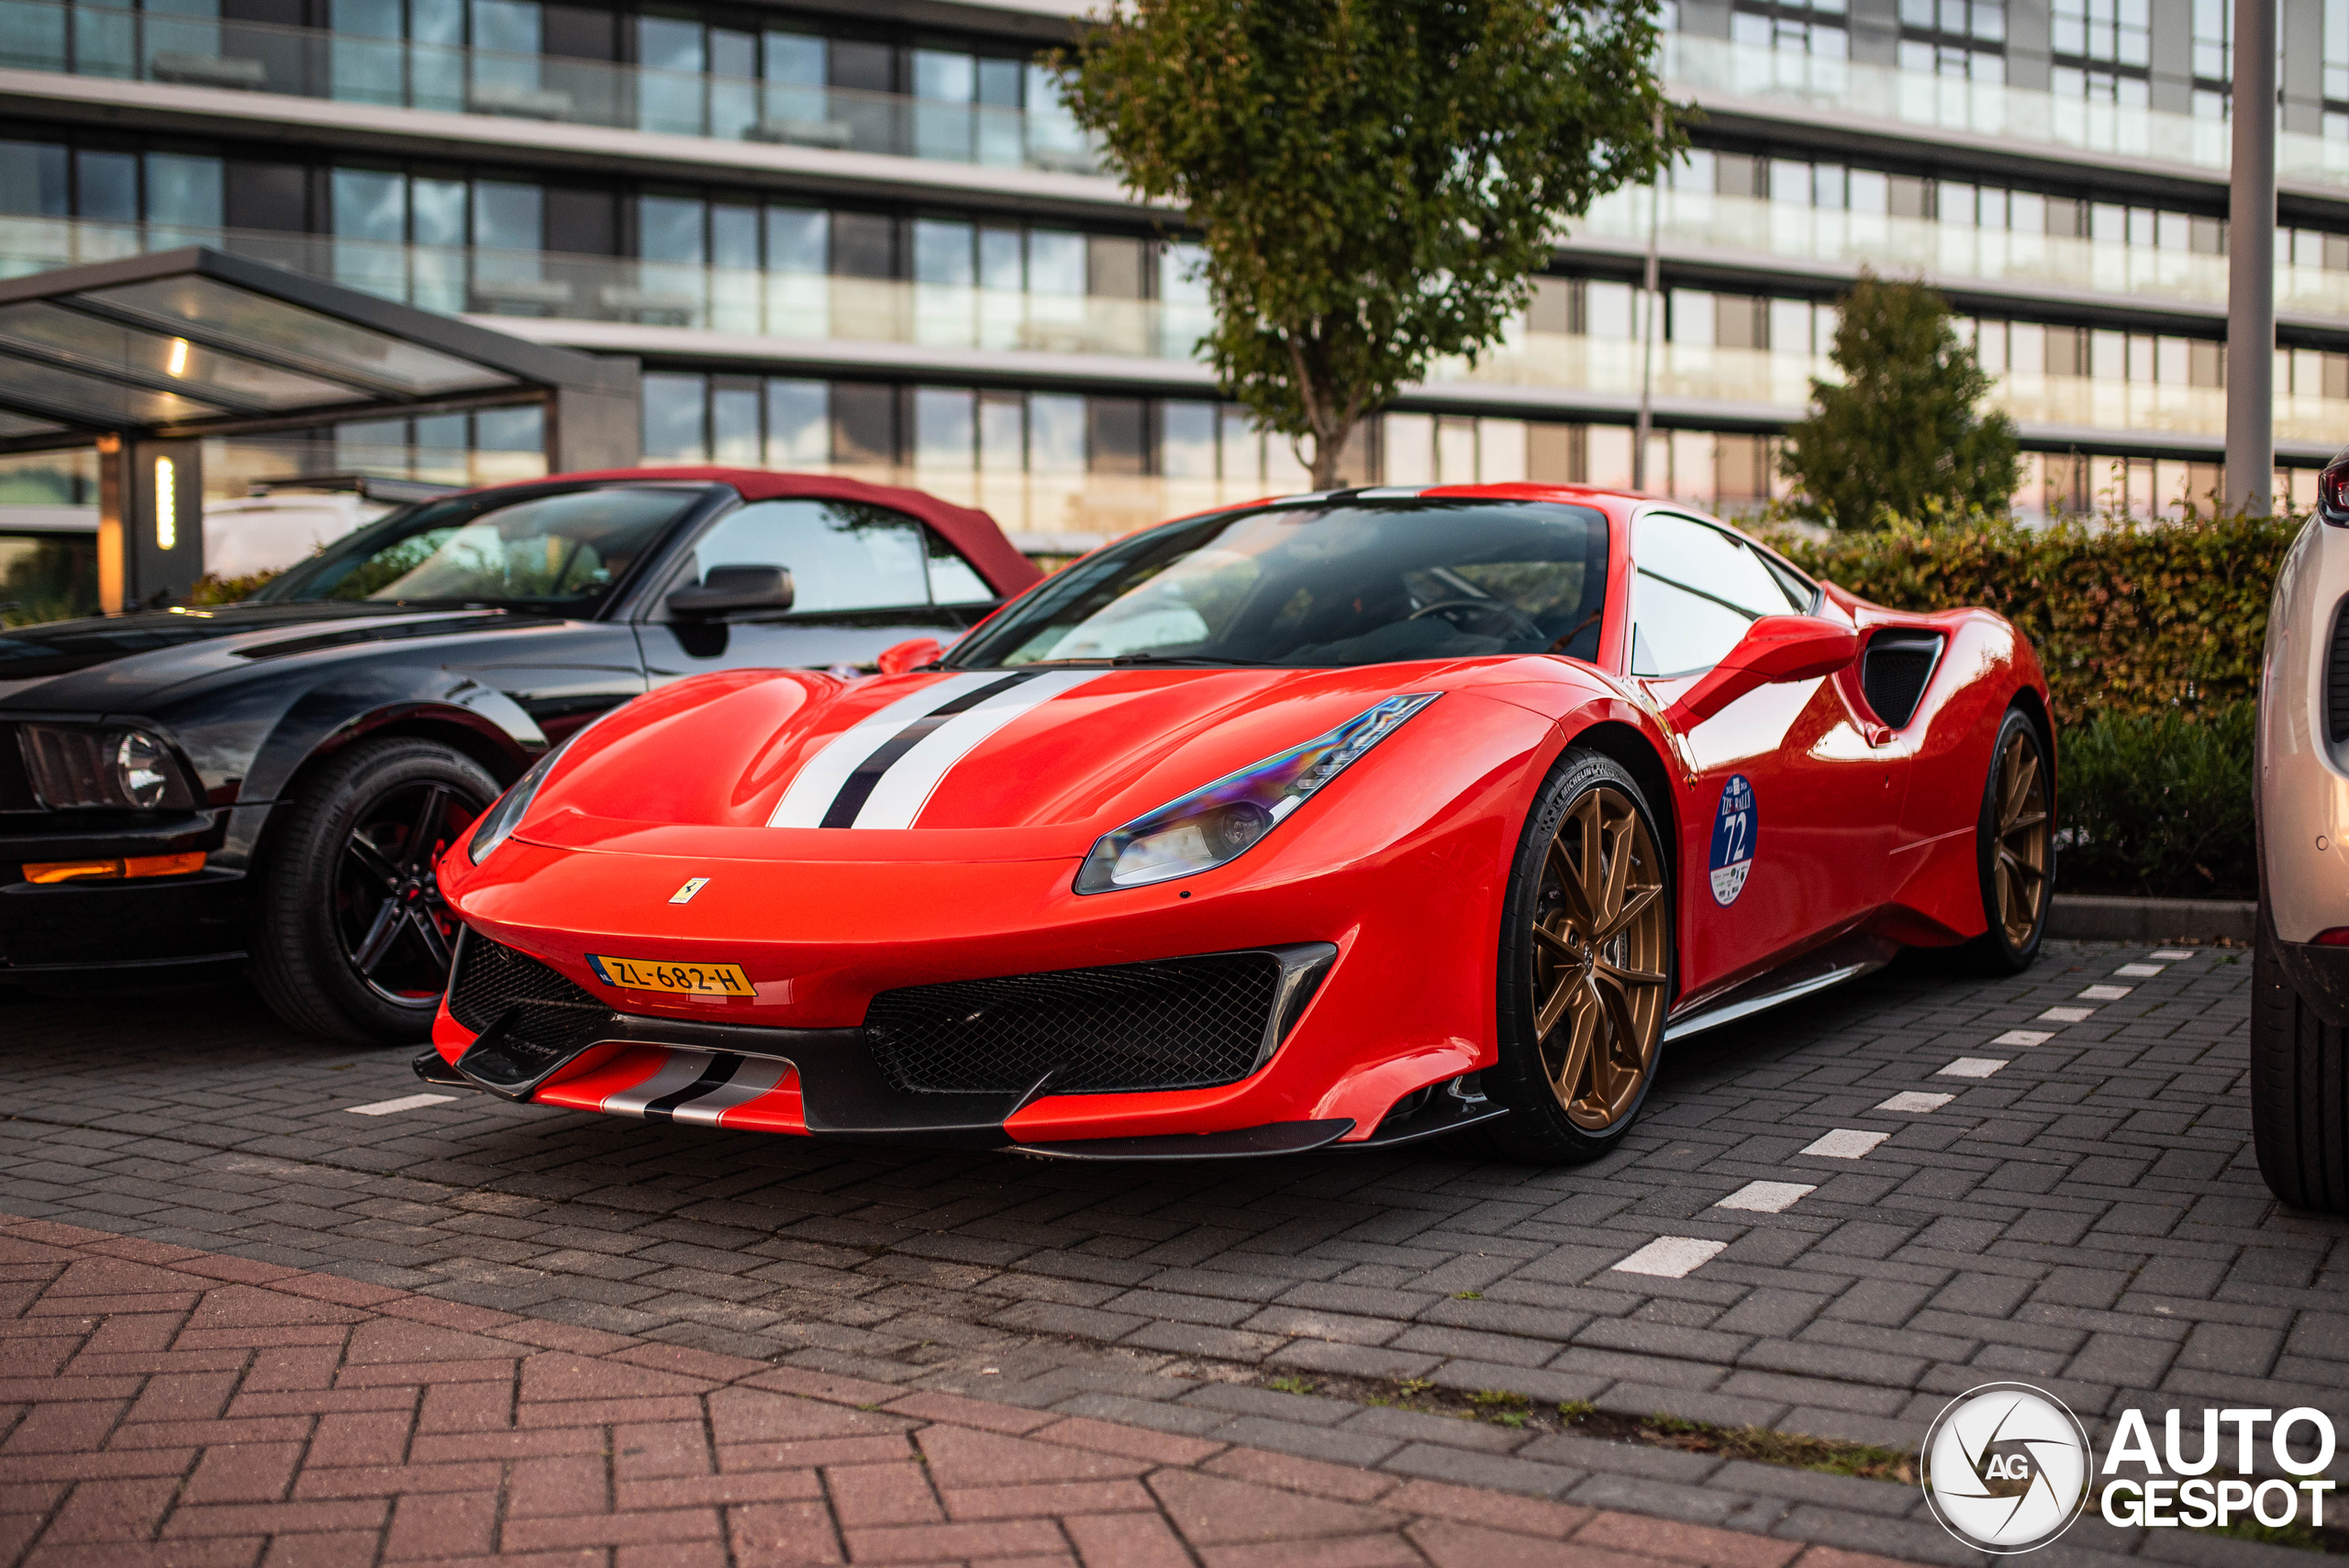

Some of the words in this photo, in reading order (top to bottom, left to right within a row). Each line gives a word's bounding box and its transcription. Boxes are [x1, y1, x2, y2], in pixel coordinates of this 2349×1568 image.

[1561, 767, 1591, 797] MICHELIN
[1735, 789, 1751, 811] RALLY
[1724, 811, 1746, 865] 72
[599, 973, 612, 982] NL
[611, 962, 741, 991] ZL-682-H
